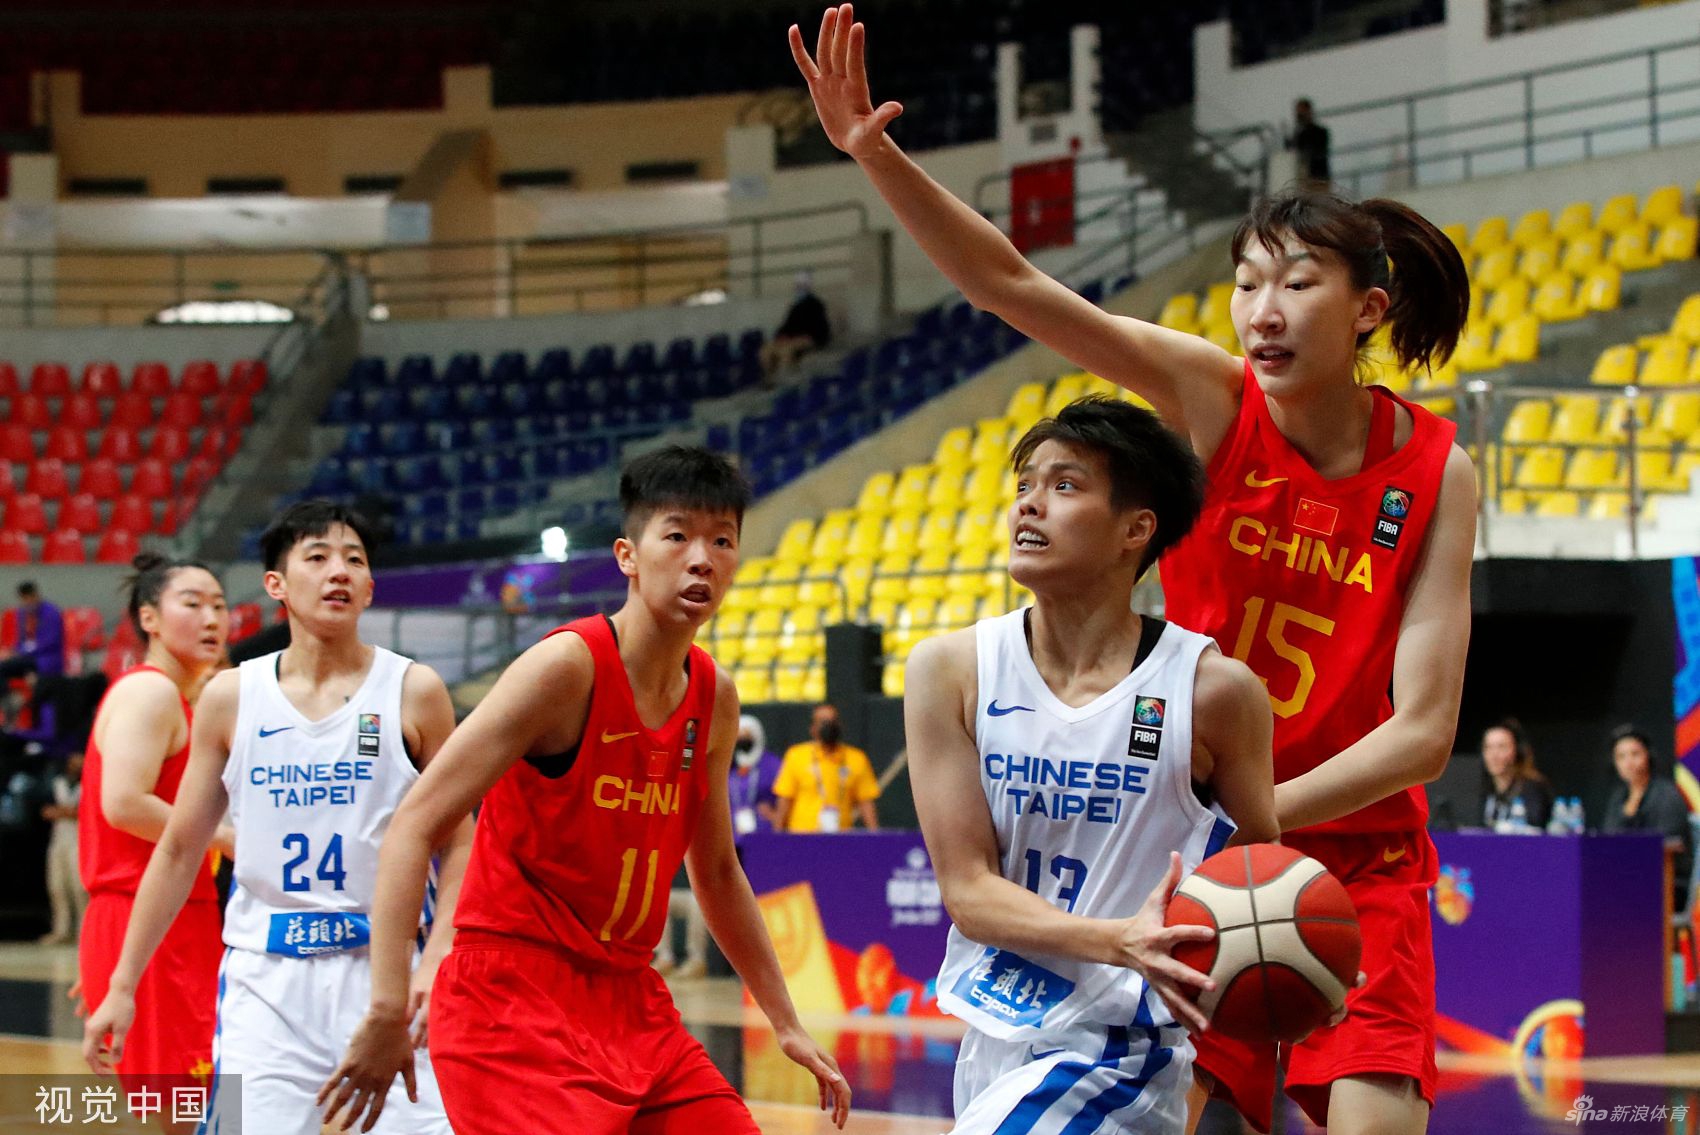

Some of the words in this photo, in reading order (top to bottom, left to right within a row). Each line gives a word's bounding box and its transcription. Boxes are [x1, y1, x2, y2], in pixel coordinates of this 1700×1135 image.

[1378, 520, 1398, 535] FIBA
[1229, 516, 1373, 593] CHINA
[1232, 596, 1336, 719] 15
[1134, 730, 1157, 744] FIBA
[250, 761, 373, 786] CHINESE
[985, 753, 1149, 794] CHINESE
[269, 785, 356, 808] TAIPEI
[592, 774, 680, 816] CHN
[1006, 788, 1122, 825] TAIPEI
[282, 832, 347, 892] 24
[1025, 848, 1088, 914] 13
[600, 847, 659, 941] 11
